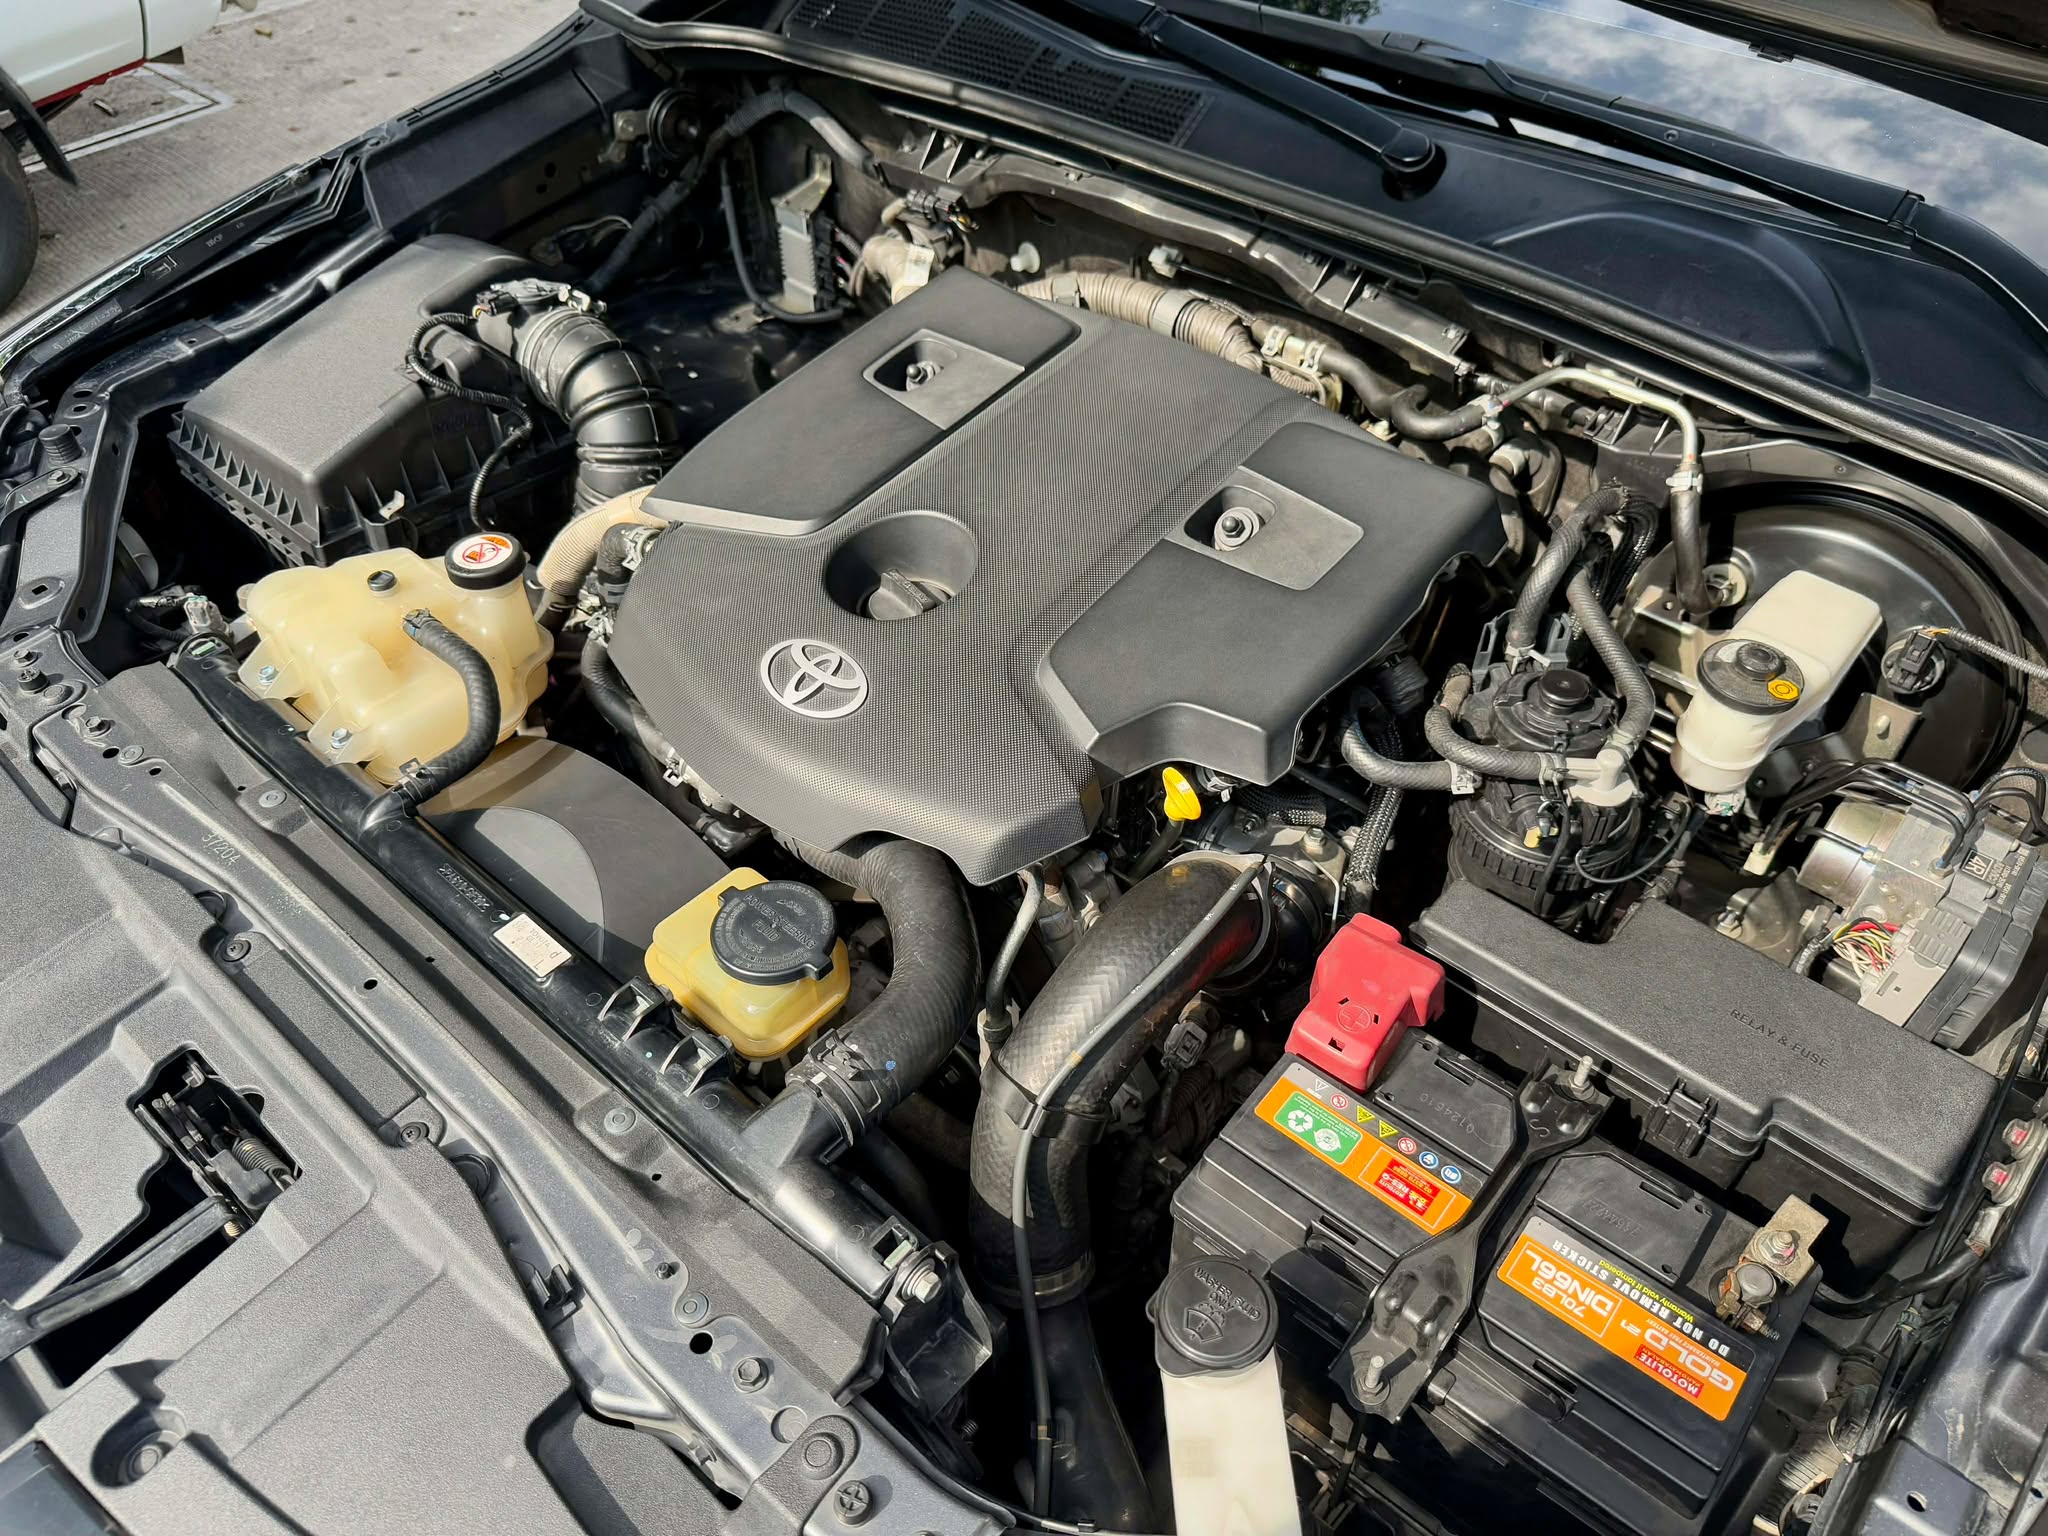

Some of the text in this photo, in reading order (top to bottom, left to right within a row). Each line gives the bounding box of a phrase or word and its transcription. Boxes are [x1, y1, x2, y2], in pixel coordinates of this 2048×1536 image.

[1965, 854, 1987, 876] 4R
[743, 893, 777, 922] POWER
[771, 915, 817, 950] STEERING
[752, 919, 781, 942] FLUID
[1730, 1009, 1776, 1037] RELAY
[1792, 1043, 1831, 1068] FUSE
[1382, 1172, 1410, 1194] RES-Q
[1525, 1248, 1615, 1316] DIN66L
[1599, 1260, 1638, 1287] tampered
[1642, 1286, 1662, 1301] void
[1194, 1266, 1261, 1322] WASHER FLUID
[1208, 1291, 1235, 1313] ONLY
[1531, 1278, 1585, 1318] 70LB3
[1552, 1239, 1731, 1357] DO NOT REMOVE STICKER
[1660, 1297, 1695, 1323] Warranty
[1619, 1319, 1735, 1391] GOLD 21
[1639, 1353, 1699, 1395] MOTOLITE
